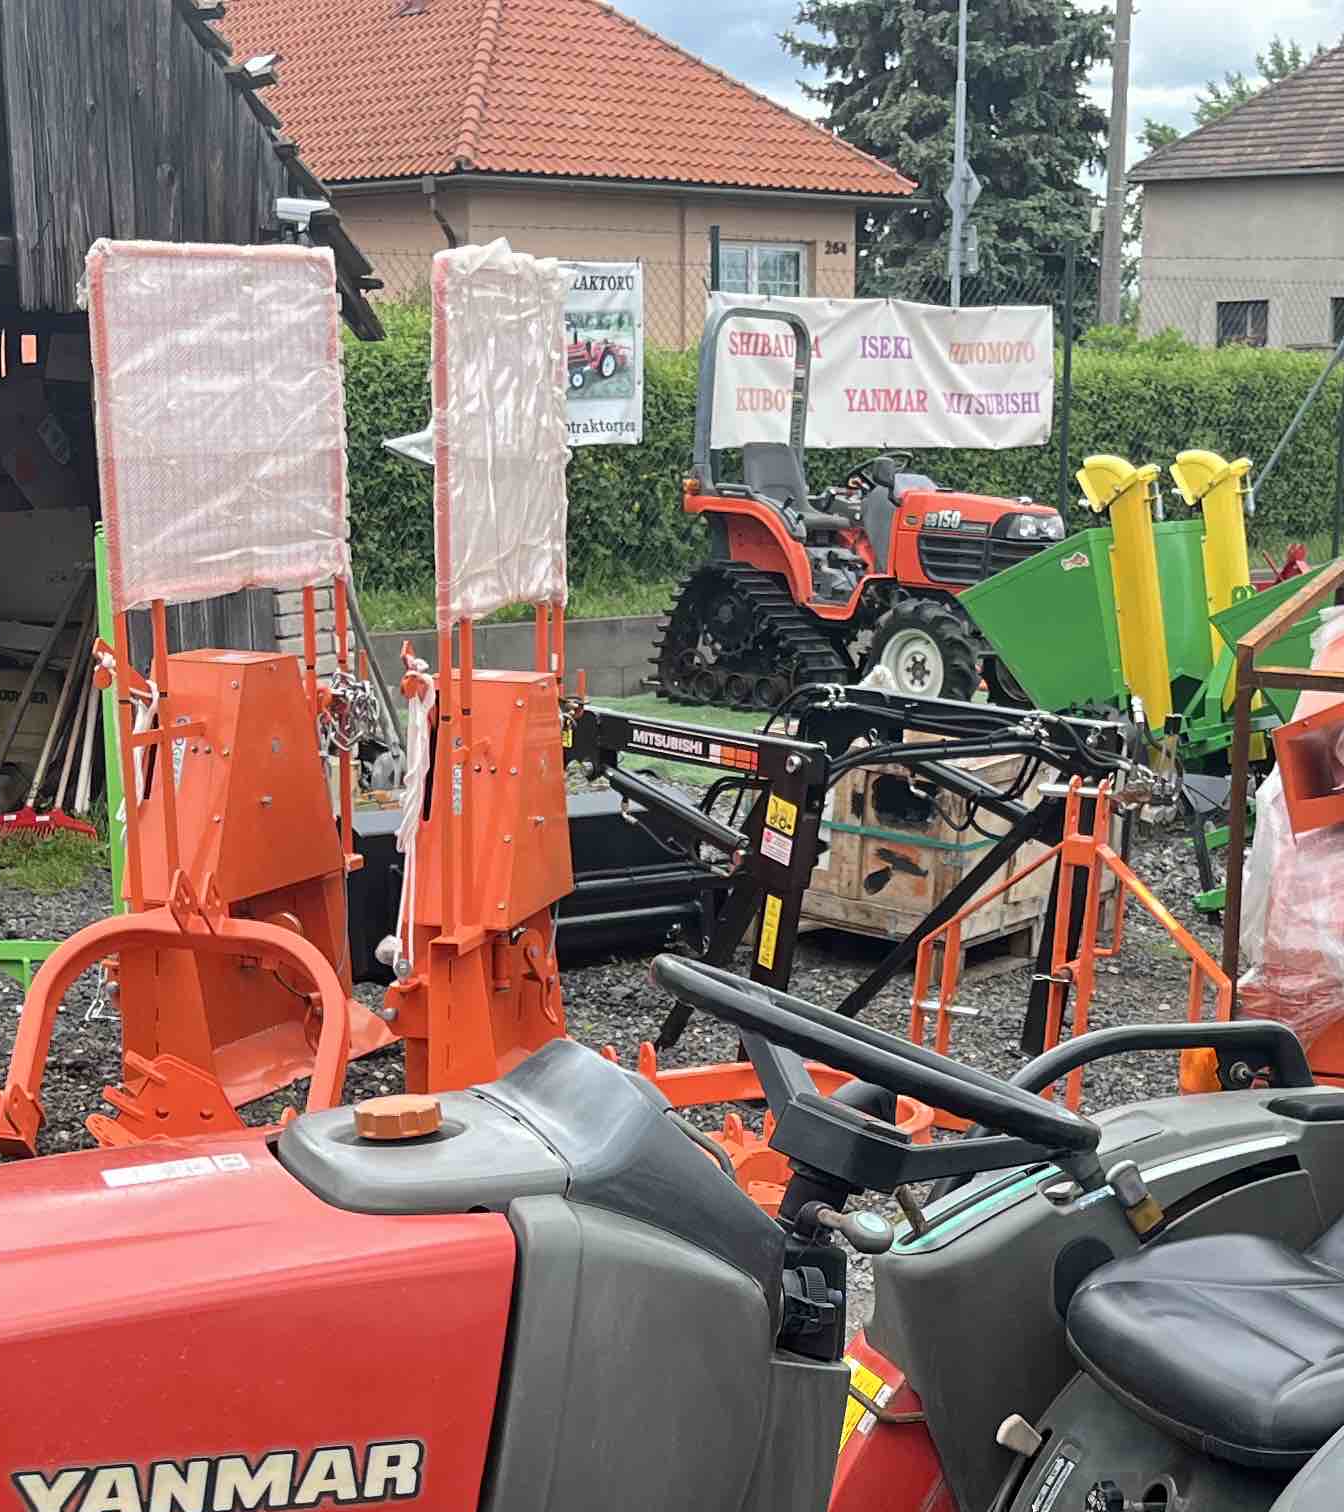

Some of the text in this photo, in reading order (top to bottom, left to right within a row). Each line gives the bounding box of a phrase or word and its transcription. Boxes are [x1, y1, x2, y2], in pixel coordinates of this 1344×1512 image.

[729, 331, 823, 359] SHIBAUA
[860, 335, 912, 360] ISEKI
[736, 386, 1040, 415] KUBOA YANMAR MITSUBISHI
[632, 727, 704, 756] MITSUBISHI
